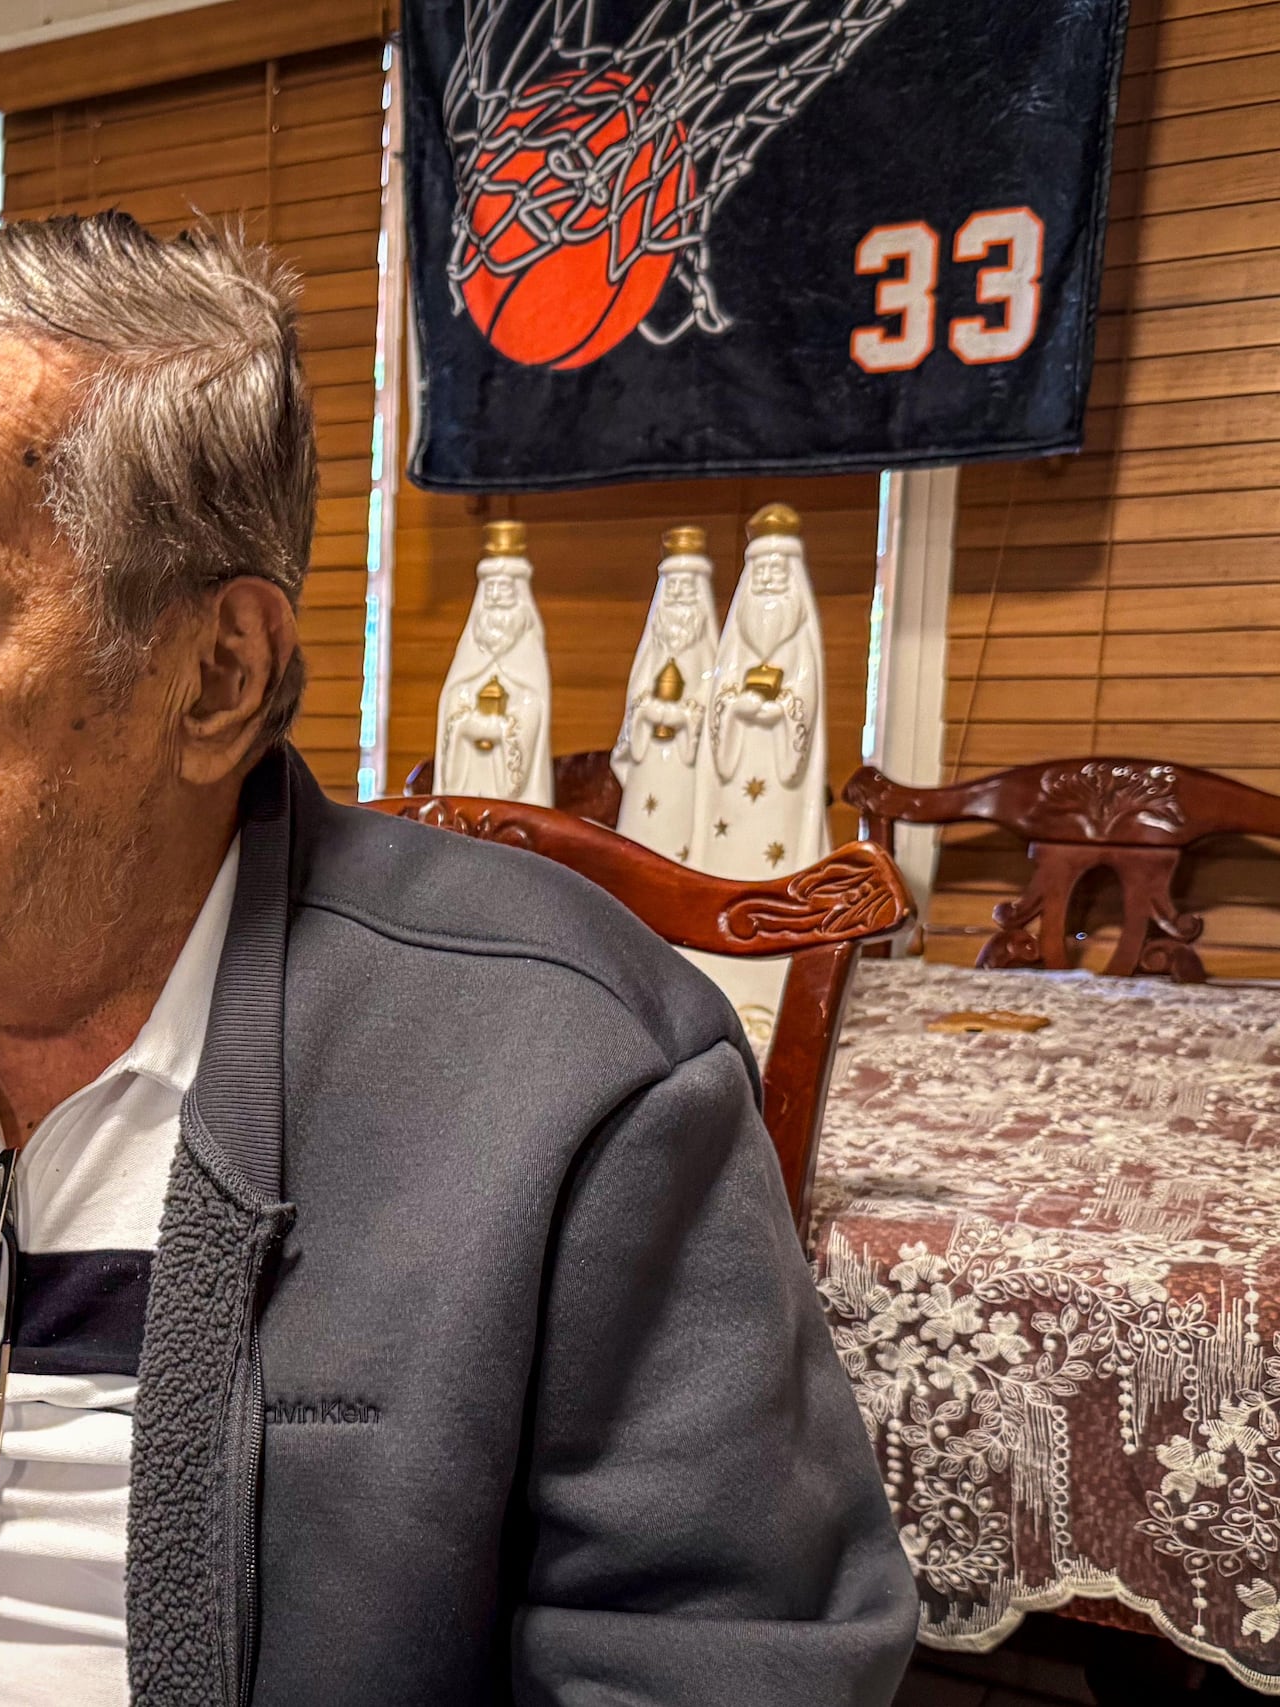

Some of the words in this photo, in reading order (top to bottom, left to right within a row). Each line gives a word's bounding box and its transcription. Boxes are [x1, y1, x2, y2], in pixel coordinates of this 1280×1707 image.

[850, 206, 1045, 374] 33
[264, 1399, 317, 1423] alvin
[321, 1398, 379, 1424] Klein
